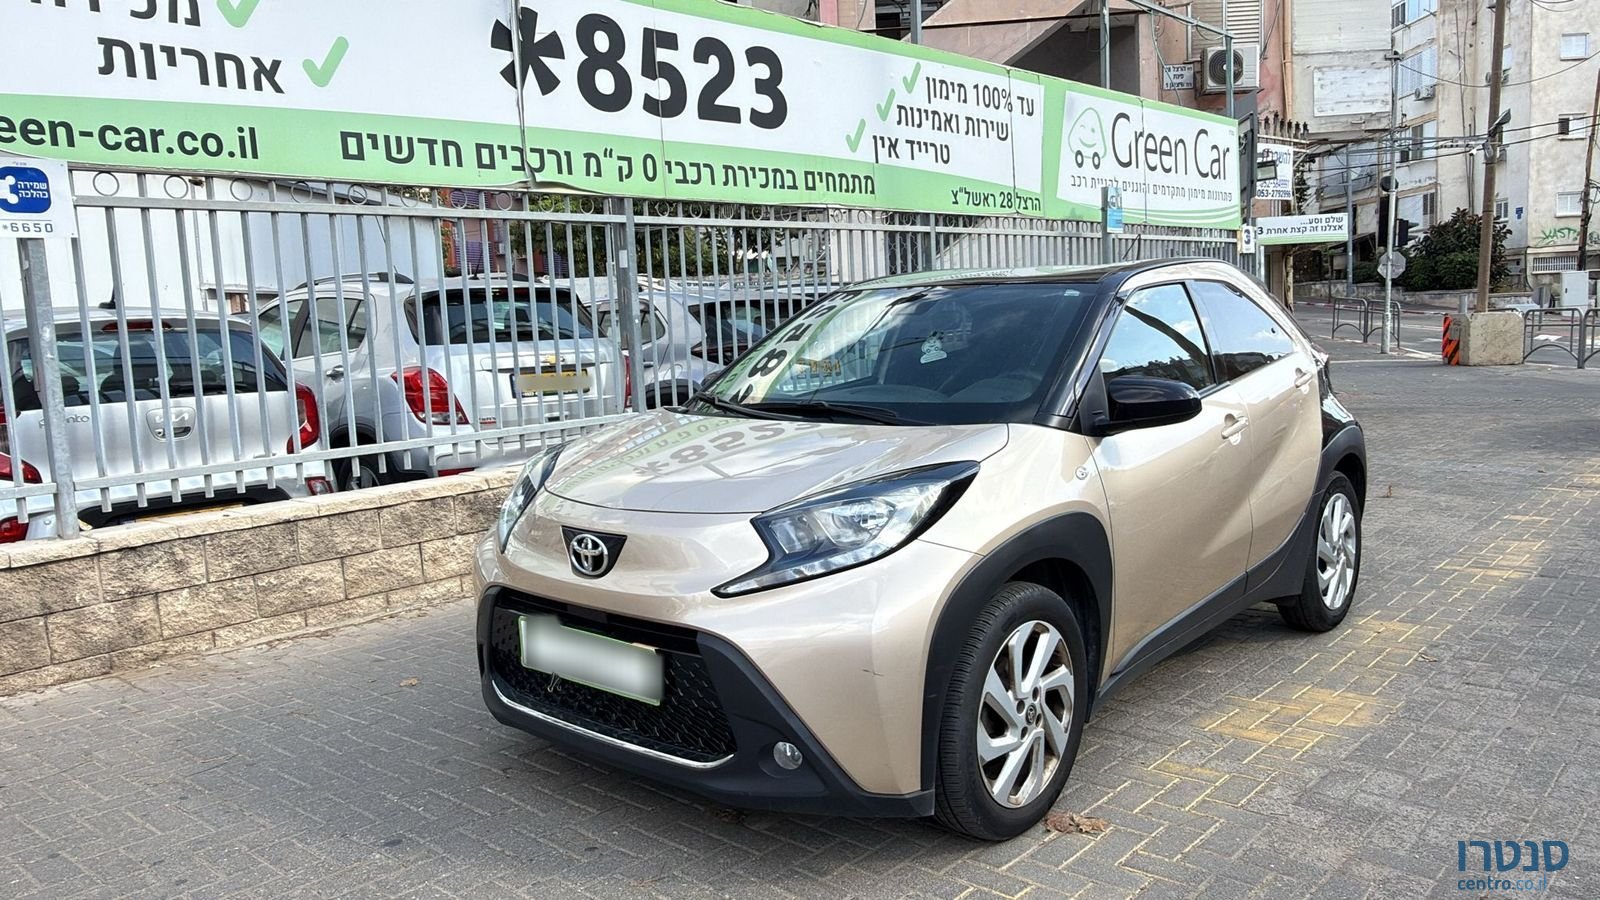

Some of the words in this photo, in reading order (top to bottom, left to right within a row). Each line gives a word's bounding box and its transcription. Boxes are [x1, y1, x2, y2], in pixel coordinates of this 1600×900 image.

[97, 36, 286, 94] אחריות
[926, 76, 968, 104] מימון
[972, 83, 1013, 113] 100%
[1016, 95, 1035, 117] עד
[896, 104, 960, 134] ואמינות
[965, 116, 1009, 141] שירות
[340, 130, 463, 169] חדשים
[872, 134, 900, 164] אין
[905, 139, 951, 165] טרייד
[1111, 112, 1188, 176] Green
[1194, 128, 1230, 180] Car
[475, 142, 573, 176] ורכבים
[642, 153, 658, 182] 0
[17, 181, 48, 190] שמירה
[664, 160, 716, 186] רכבי
[722, 163, 798, 191] במכירת
[804, 169, 876, 195] מתמחים
[1071, 174, 1088, 188] רכב
[18, 189, 49, 198] כהלכה
[1000, 193, 1014, 209] 28
[1015, 194, 1042, 212] הרצל
[1152, 183, 1186, 199] מתקדמים
[1187, 187, 1206, 201] מימון
[1207, 190, 1233, 202] פתרונות
[1266, 227, 1289, 235] אחרת
[1290, 225, 1307, 234] קצת
[1309, 225, 1318, 233] זה
[1325, 216, 1344, 224] שלם
